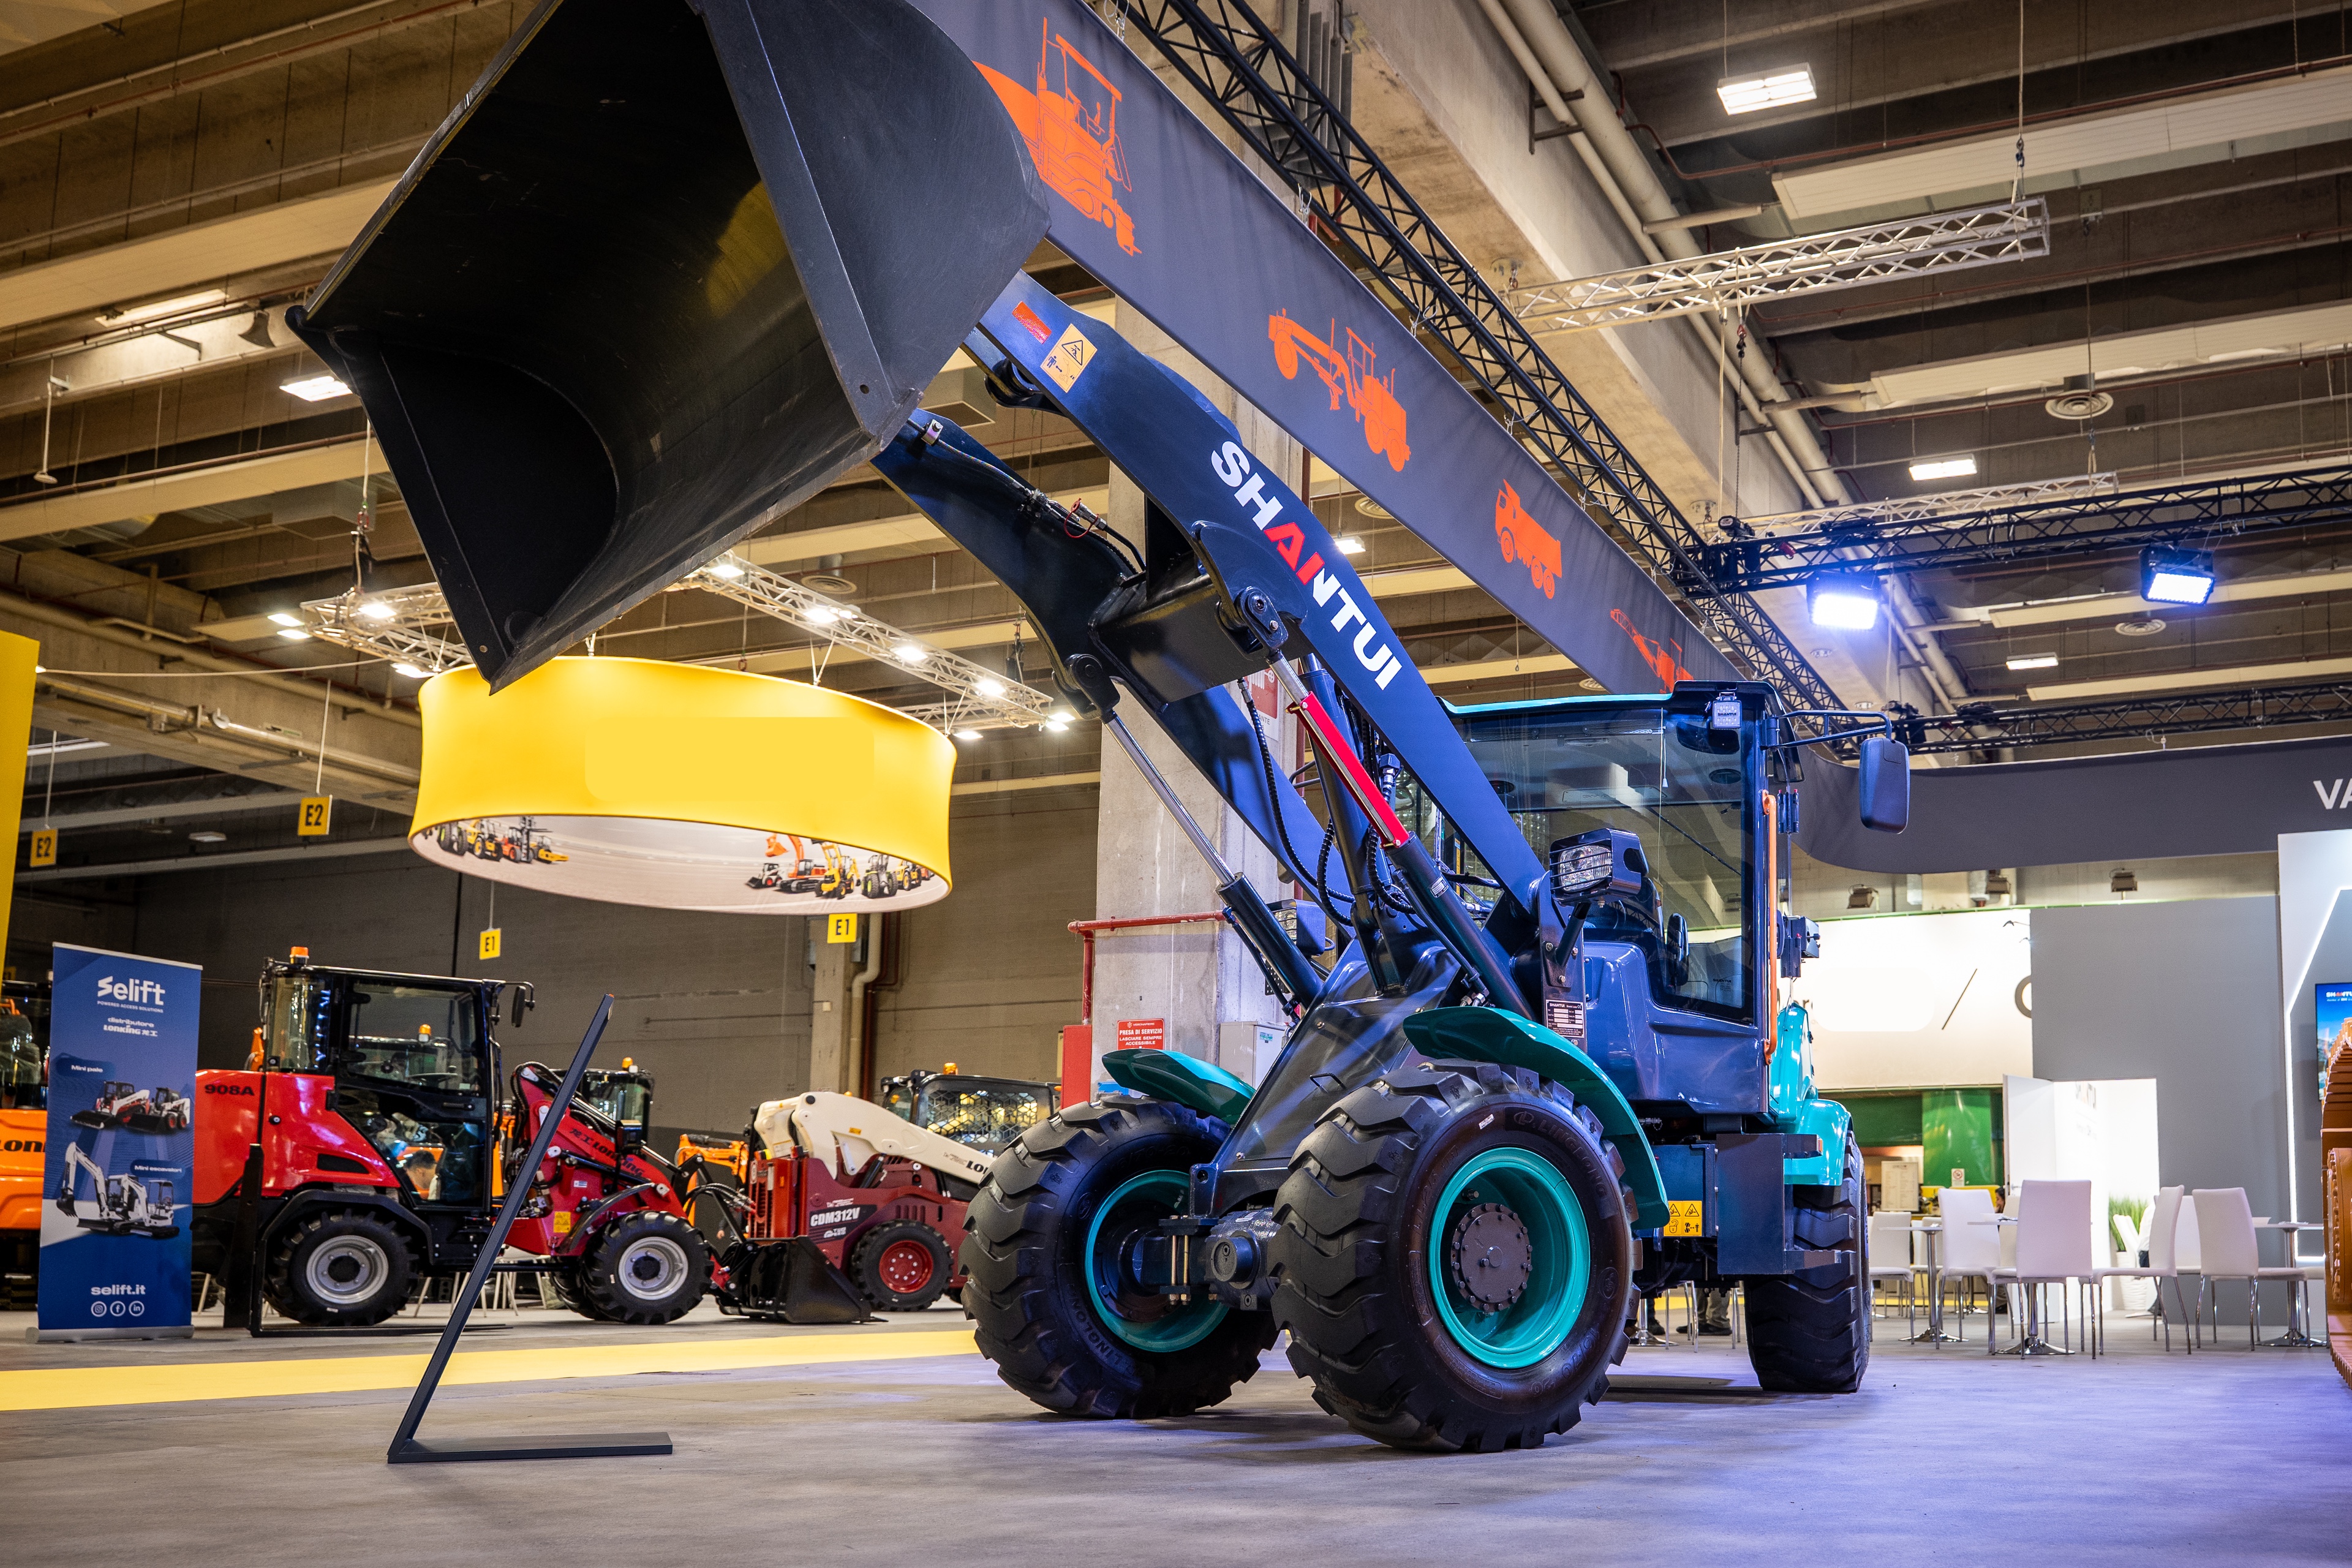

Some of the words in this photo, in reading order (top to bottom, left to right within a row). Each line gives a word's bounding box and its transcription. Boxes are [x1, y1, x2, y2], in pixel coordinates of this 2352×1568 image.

[1211, 440, 1403, 691] SHANTUI
[305, 804, 323, 826] E2
[37, 836, 51, 858] E2
[835, 919, 850, 935] E1
[484, 936, 495, 952] E1
[97, 976, 166, 1006] Selift
[204, 1084, 255, 1096] 908A
[810, 1207, 861, 1227] CDM312V
[91, 1284, 146, 1295] selift.it
